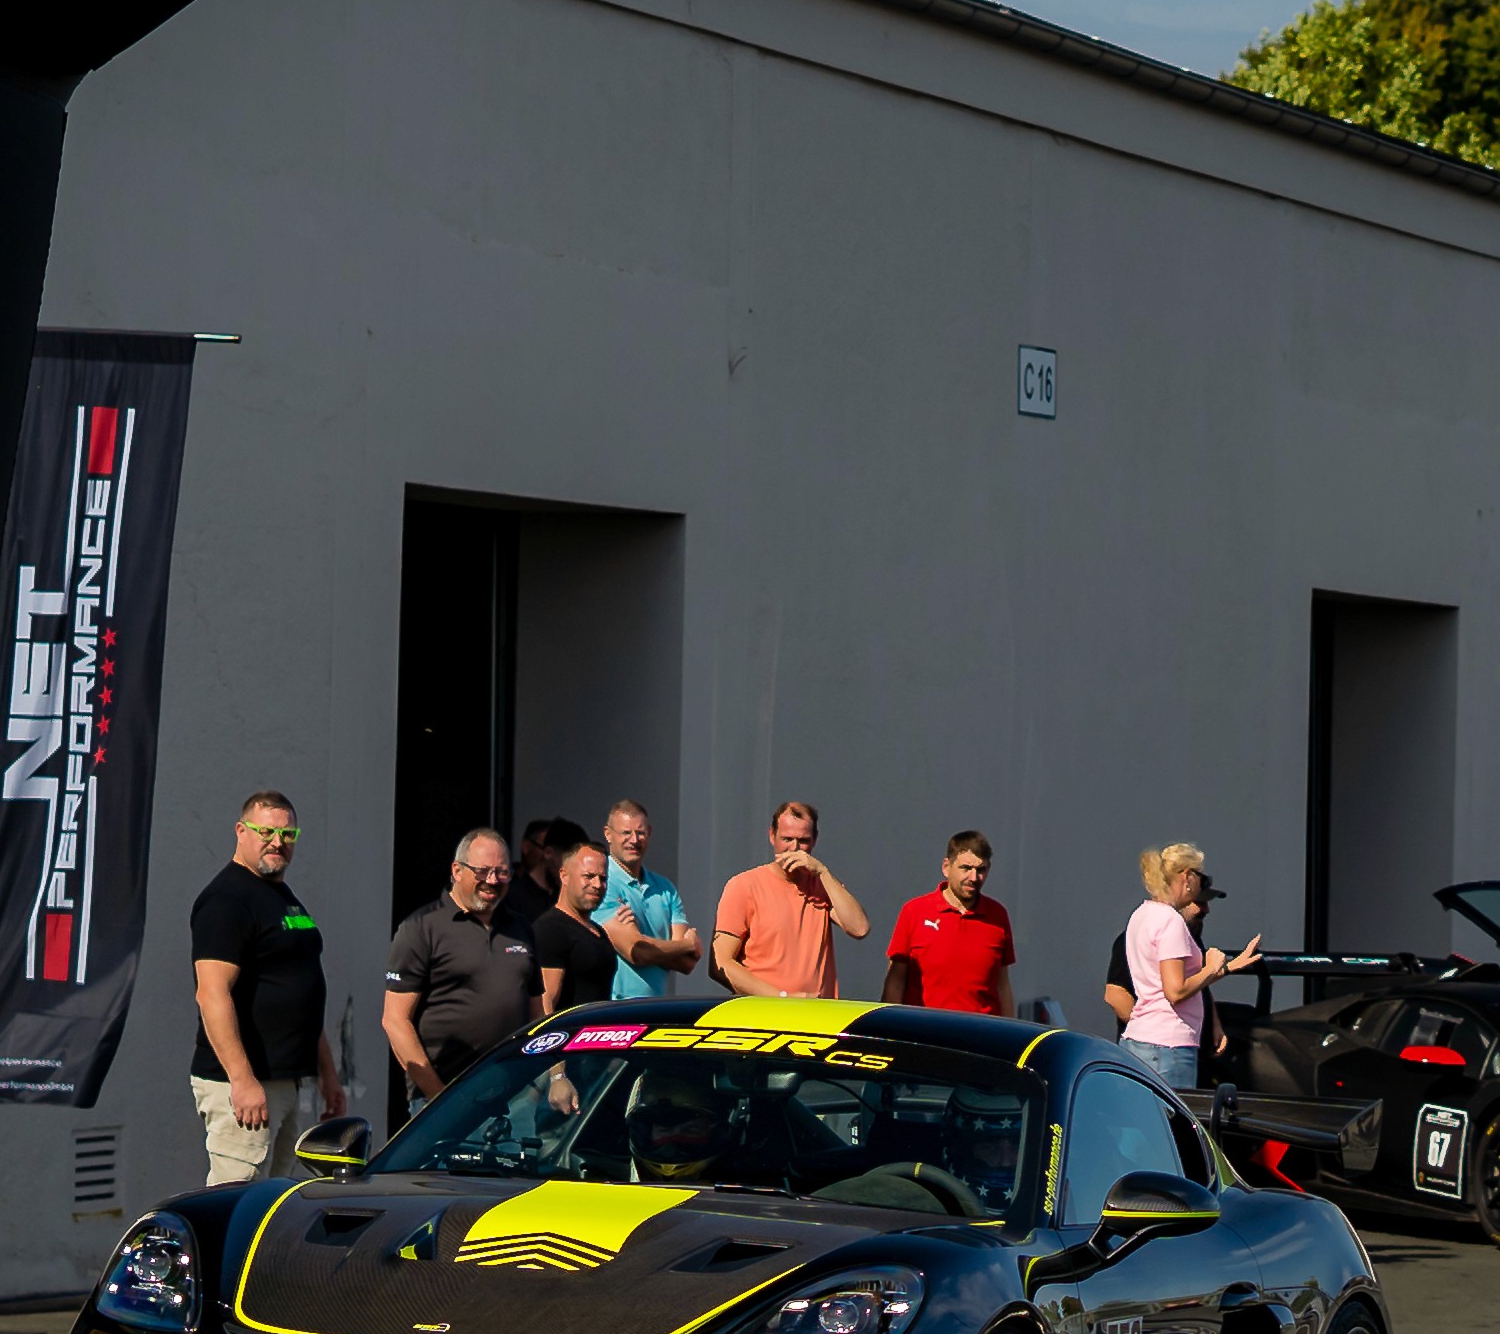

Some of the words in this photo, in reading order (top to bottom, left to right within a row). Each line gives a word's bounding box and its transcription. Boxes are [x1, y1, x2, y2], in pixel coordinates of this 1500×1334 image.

[1024, 361, 1034, 400] C
[1038, 364, 1052, 403] 16
[2, 565, 67, 800] NET
[46, 479, 111, 909] PERFORMANCE
[574, 1030, 638, 1044] PITBOX
[632, 1028, 838, 1056] SSR
[825, 1051, 894, 1070] CS
[1427, 1131, 1452, 1167] 67
